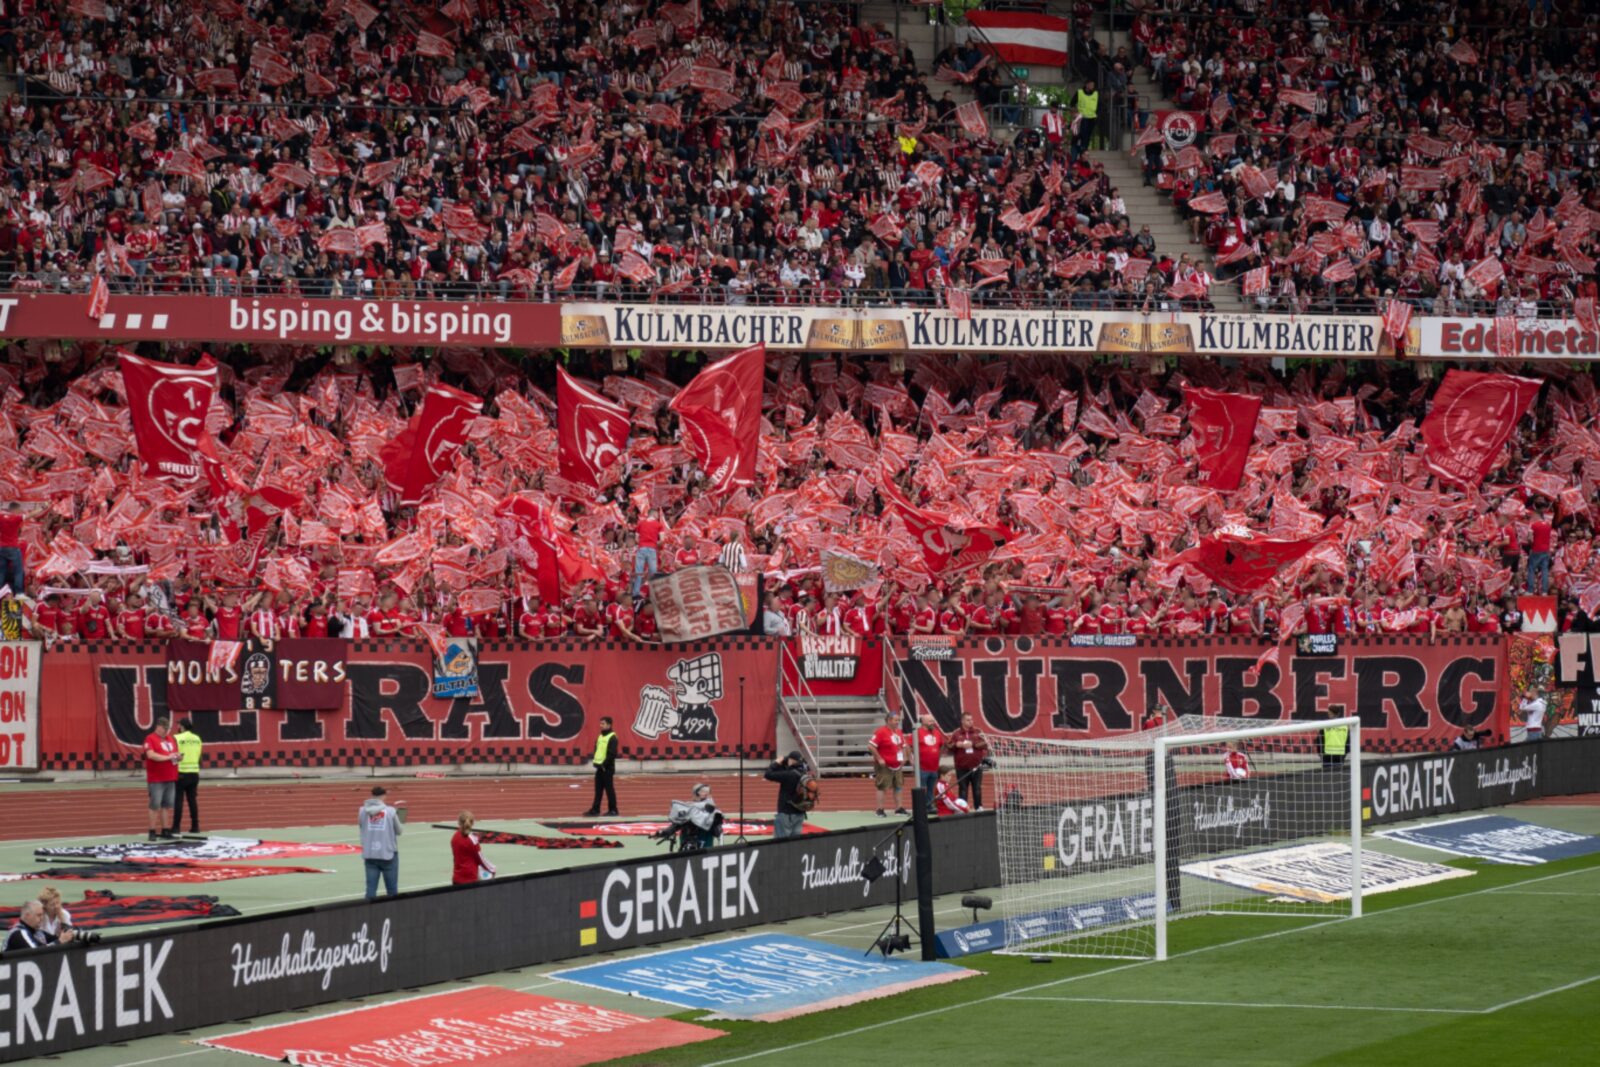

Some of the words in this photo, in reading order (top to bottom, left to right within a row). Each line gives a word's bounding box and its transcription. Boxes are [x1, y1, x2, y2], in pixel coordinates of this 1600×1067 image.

[230, 299, 352, 340] bisping
[360, 302, 384, 332] &
[391, 303, 511, 343] bisping
[614, 307, 804, 344] KULMBACHER
[912, 312, 1094, 347] KULMBACHER
[1199, 316, 1374, 351] KULMBACHER
[0, 645, 28, 680] ON
[801, 636, 857, 655] RESPEKT
[279, 659, 346, 682] TERS
[433, 677, 479, 692] ULTRAS
[804, 657, 857, 678] RIVALITÄT
[894, 636, 1497, 736] NÜRNBERG
[0, 691, 26, 723] ON
[683, 717, 713, 734] 1994
[1373, 758, 1455, 816] GERATEK
[1058, 799, 1151, 866] GERATE
[601, 849, 760, 940] GERATEK
[232, 922, 378, 991] Haushaltsgeräte
